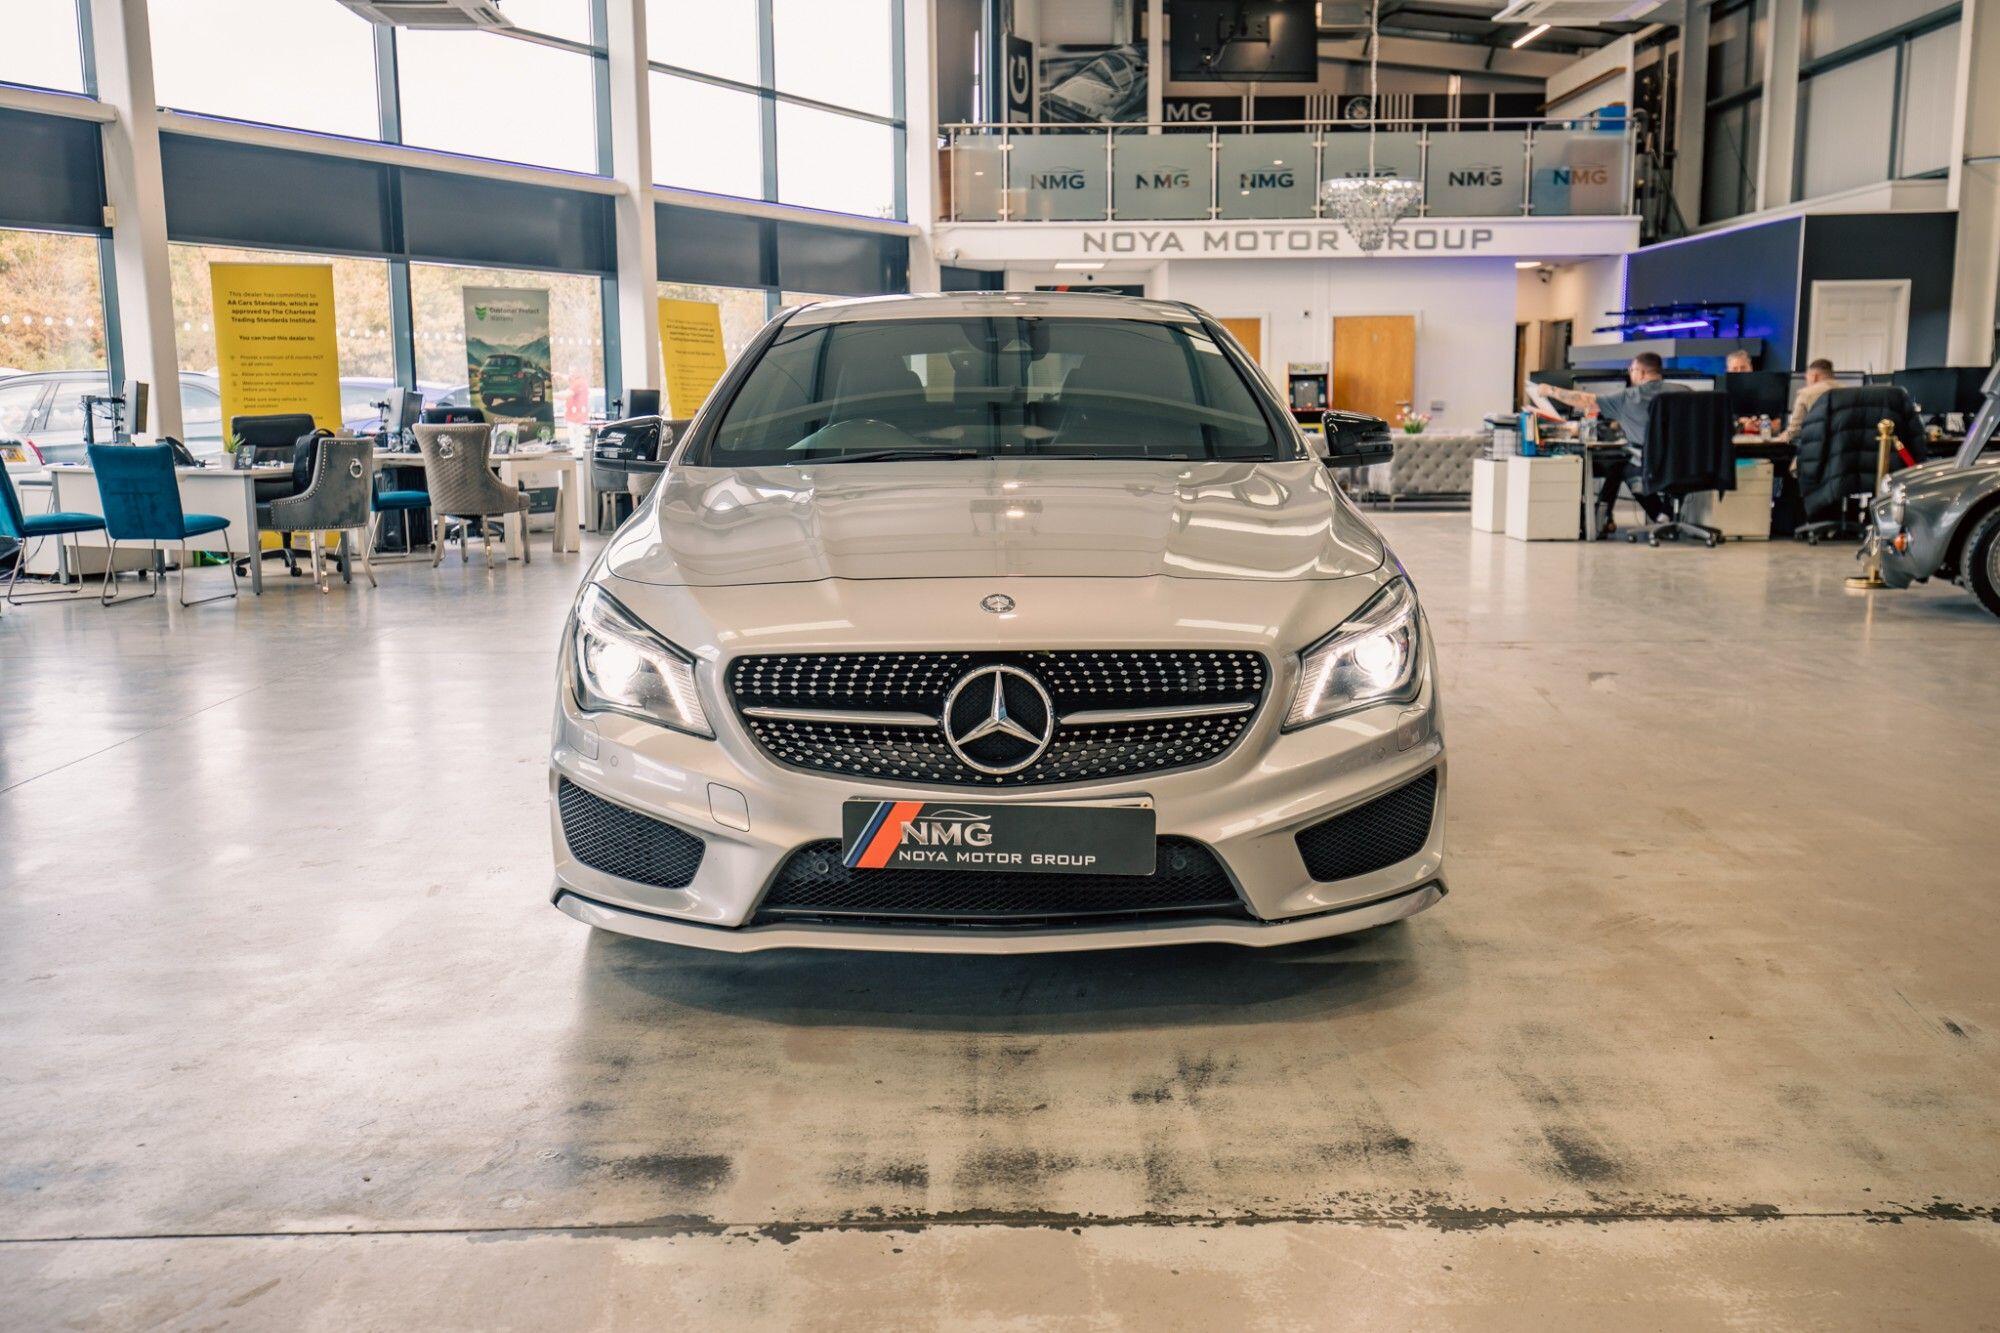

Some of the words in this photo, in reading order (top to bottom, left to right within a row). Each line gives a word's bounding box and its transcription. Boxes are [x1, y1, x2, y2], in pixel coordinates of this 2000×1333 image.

[1031, 174, 1085, 190] NMG
[1136, 173, 1190, 189] NMG
[1240, 173, 1295, 189] NMG
[1448, 171, 1504, 187] NMG
[1553, 169, 1608, 186] NMG
[1083, 231, 1184, 252] NOYA
[1203, 230, 1339, 251] MOTOR
[1376, 229, 1493, 250] ROUP
[900, 821, 993, 847] NMG
[898, 850, 949, 862] NOYA
[956, 852, 1022, 864] MOTOR
[1030, 854, 1096, 866] GROUP
